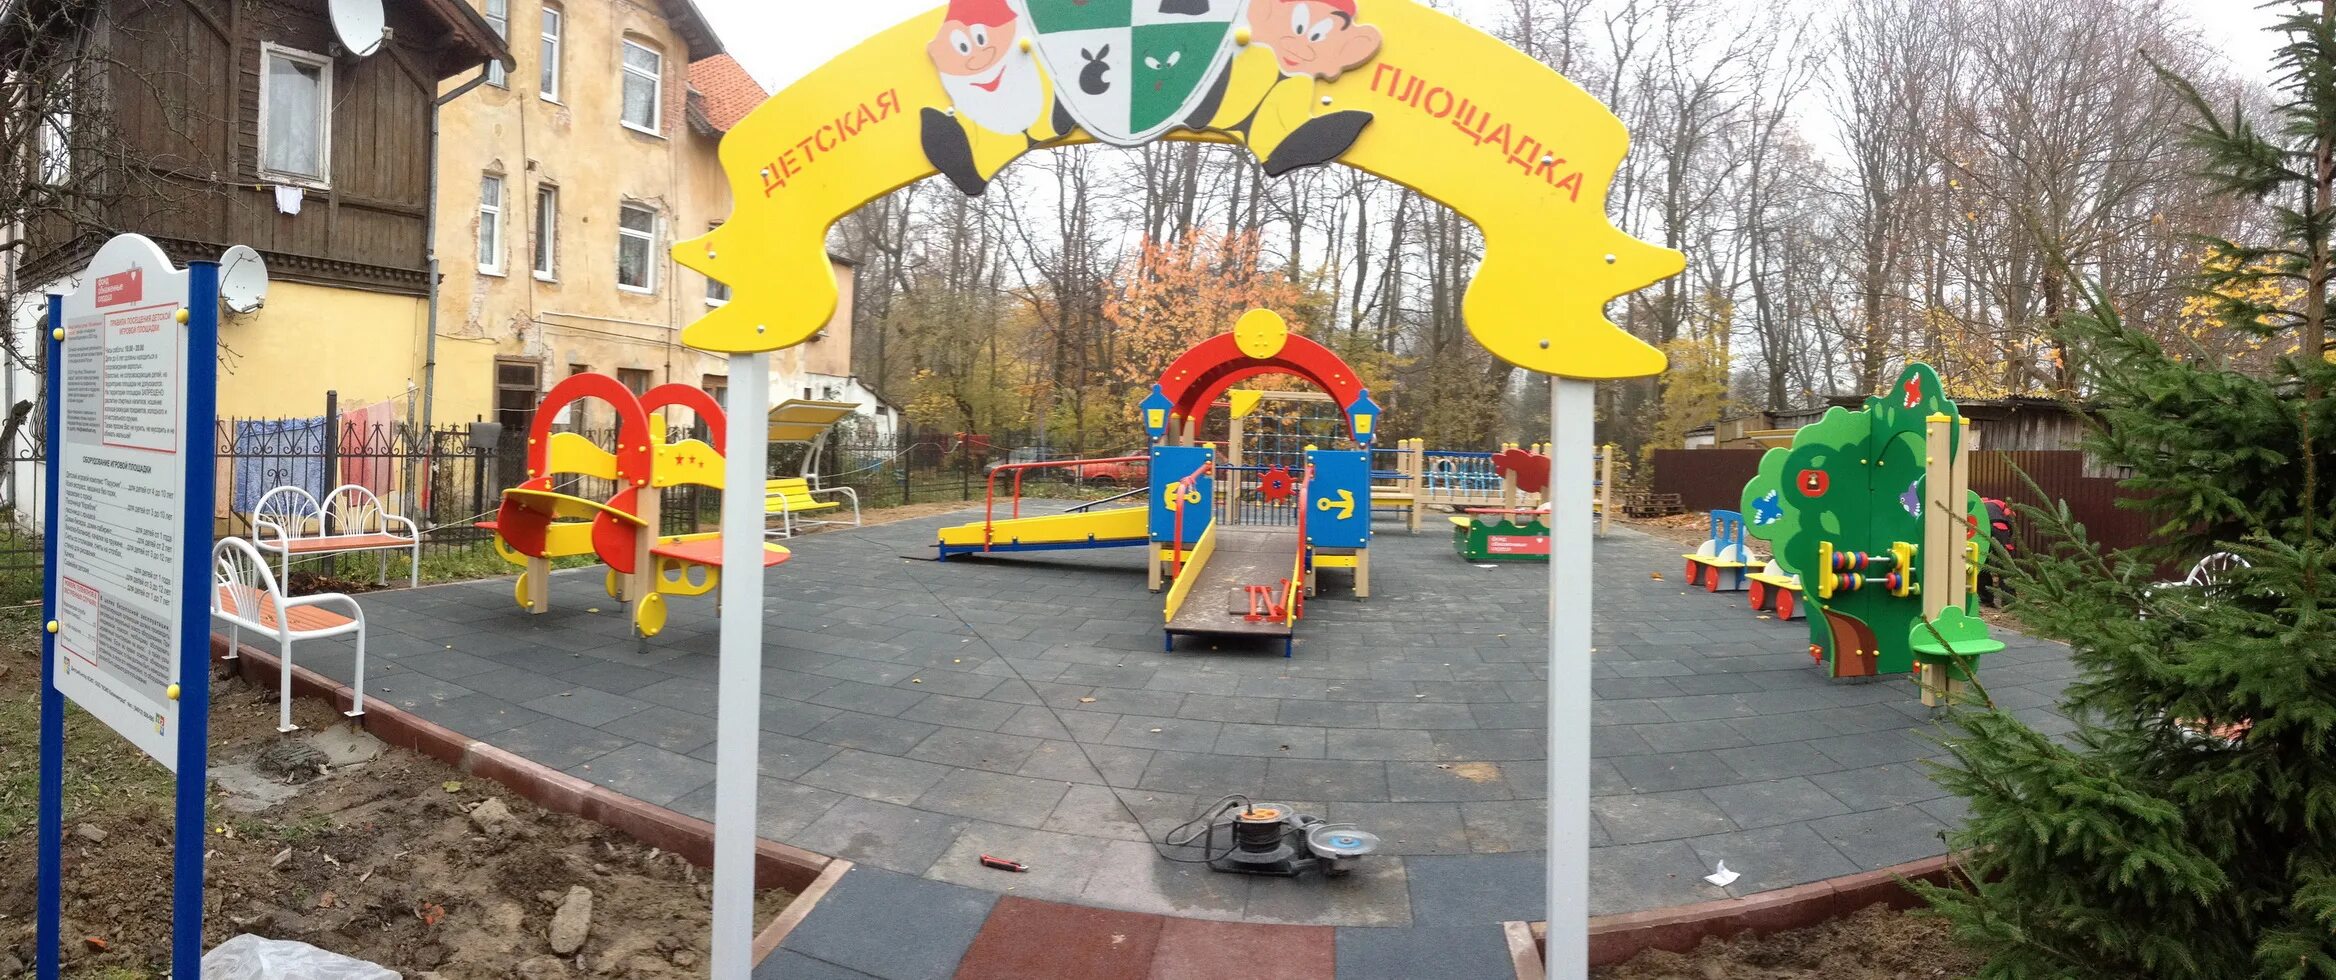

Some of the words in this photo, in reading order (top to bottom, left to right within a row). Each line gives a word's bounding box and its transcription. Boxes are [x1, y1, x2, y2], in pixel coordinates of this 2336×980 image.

[761, 88, 901, 198] ДЕТСКАЯ
[1370, 63, 1584, 203] ПЛОЩАДКА
[128, 315, 151, 324] ПОСЕЩЕНИЯ
[152, 311, 171, 322] ДЕТСКОЙ
[82, 455, 110, 467] ОБОРУДОВАНИЕ
[110, 459, 128, 469] ИГРОВОЙ
[128, 462, 151, 473] ПЛОЩАДКИ
